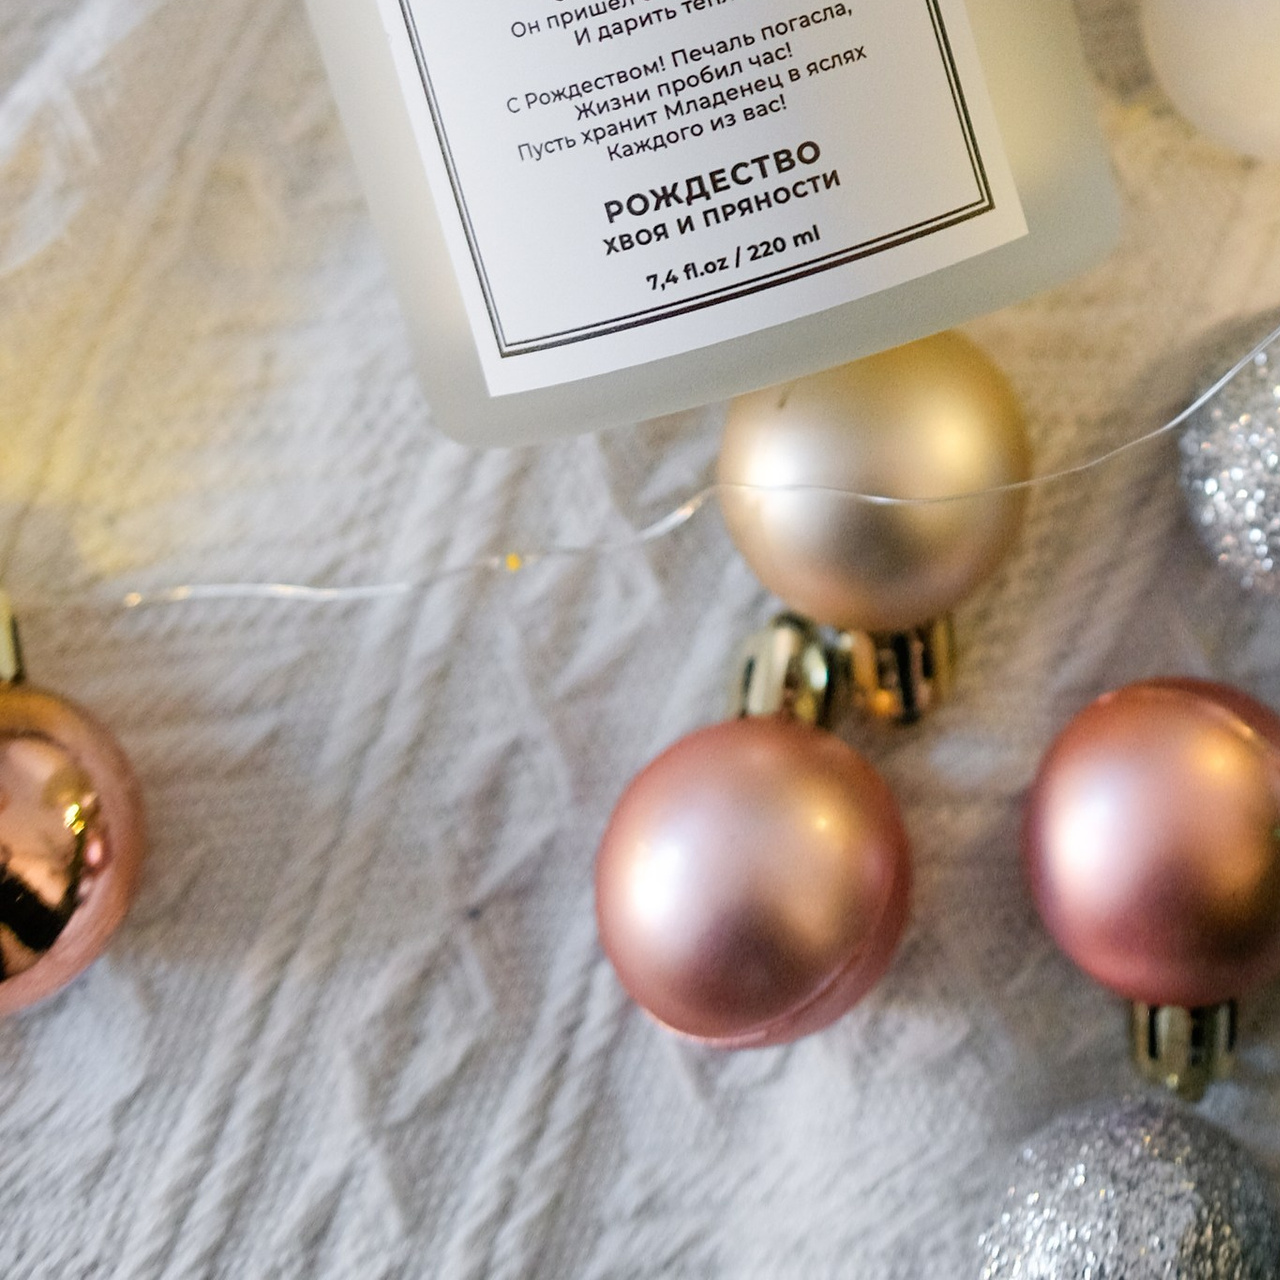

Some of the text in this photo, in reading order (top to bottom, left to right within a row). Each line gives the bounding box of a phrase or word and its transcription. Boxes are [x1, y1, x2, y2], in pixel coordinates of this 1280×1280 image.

[505, 2, 852, 114] С Рождеством! Печаль погасла,
[510, 19, 541, 38] Он
[573, 26, 591, 46] И
[597, 6, 677, 43] дарить
[516, 44, 867, 162] Пусть хранит Младенец в яслях
[573, 40, 793, 121] Жизни пробил час!
[606, 92, 787, 161] Каждого из вас!
[601, 168, 841, 256] ХВОЯ И ПРЯНОСТИ
[603, 140, 821, 224] РОЖДЕСТВО
[644, 223, 821, 291] 7,4 fl.oz / 220 ml
